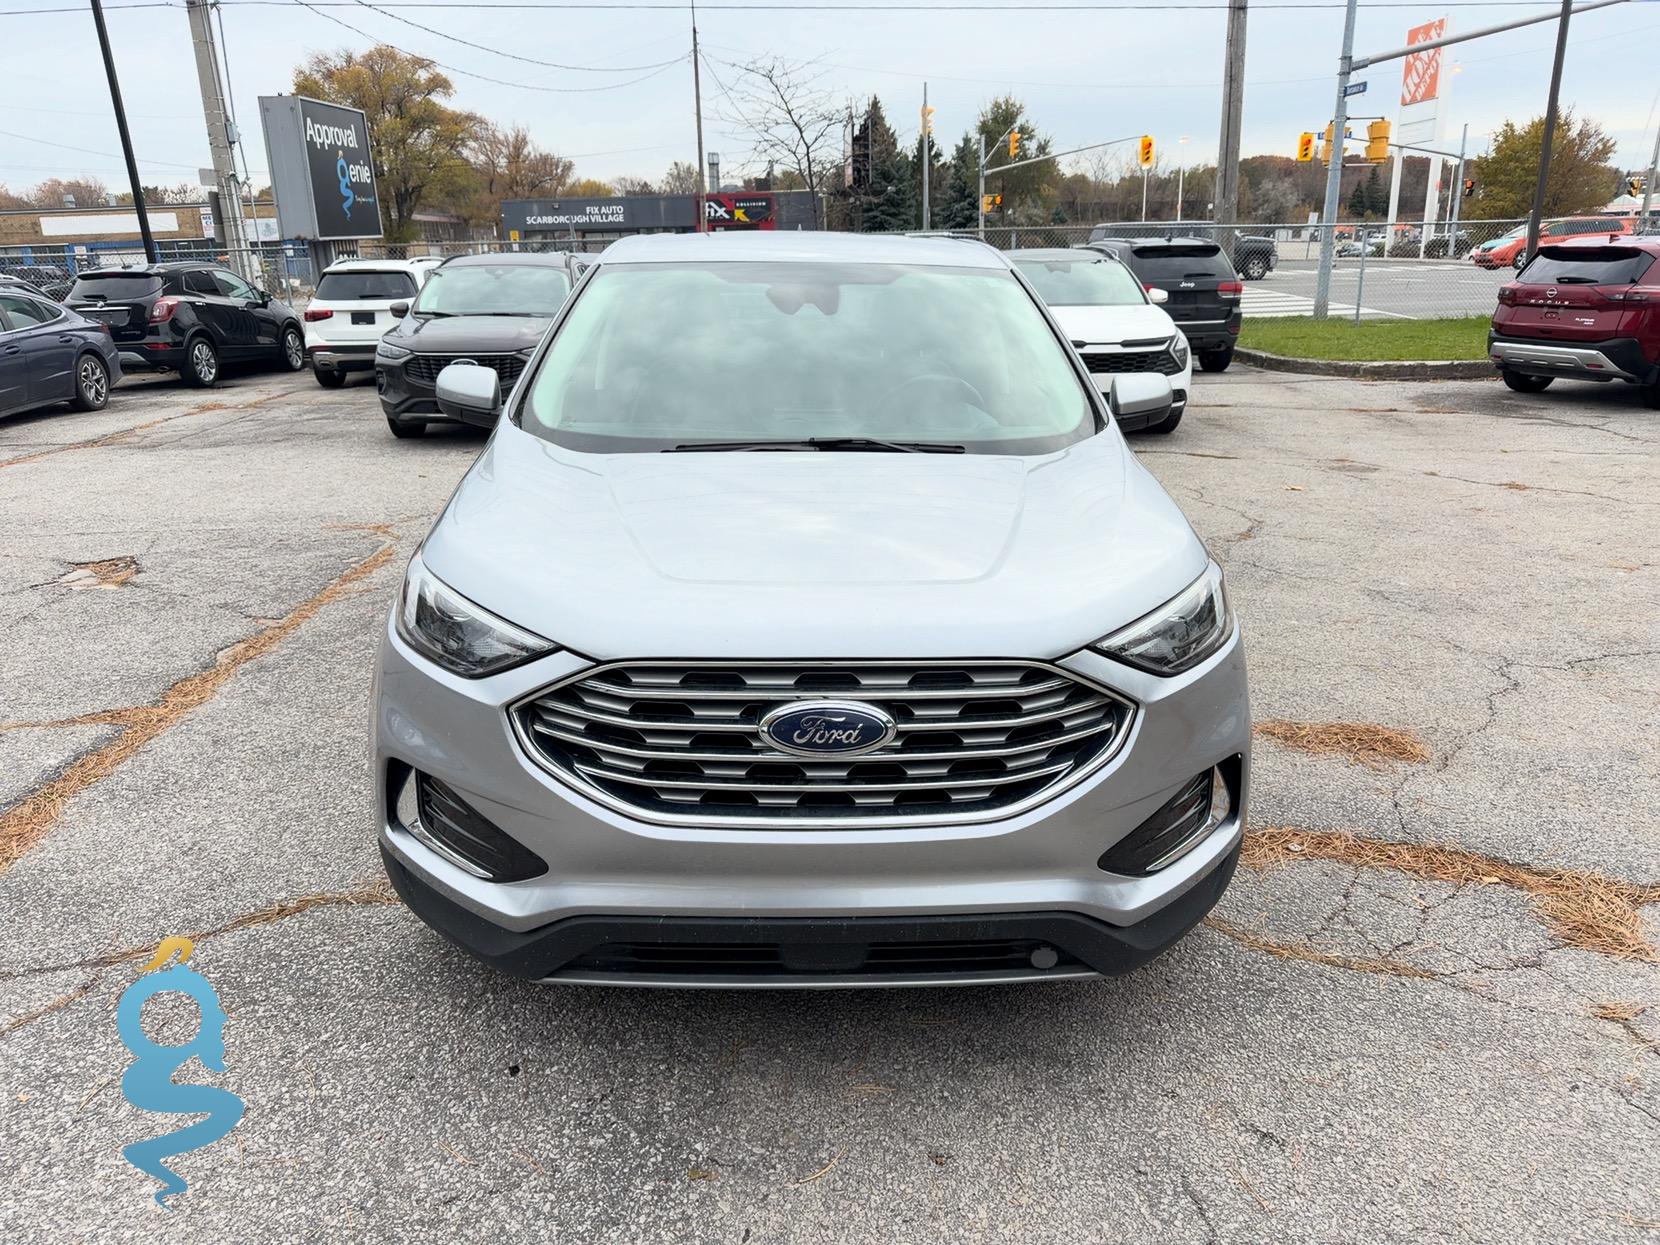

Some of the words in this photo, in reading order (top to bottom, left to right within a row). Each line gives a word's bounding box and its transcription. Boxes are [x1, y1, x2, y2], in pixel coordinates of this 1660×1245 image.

[306, 117, 358, 150] Approval
[586, 206, 600, 215] FIX
[601, 205, 624, 214] AUTO
[590, 213, 625, 223] VILLAGE
[1179, 281, 1196, 289] Jeep
[793, 715, 864, 744] Ford
